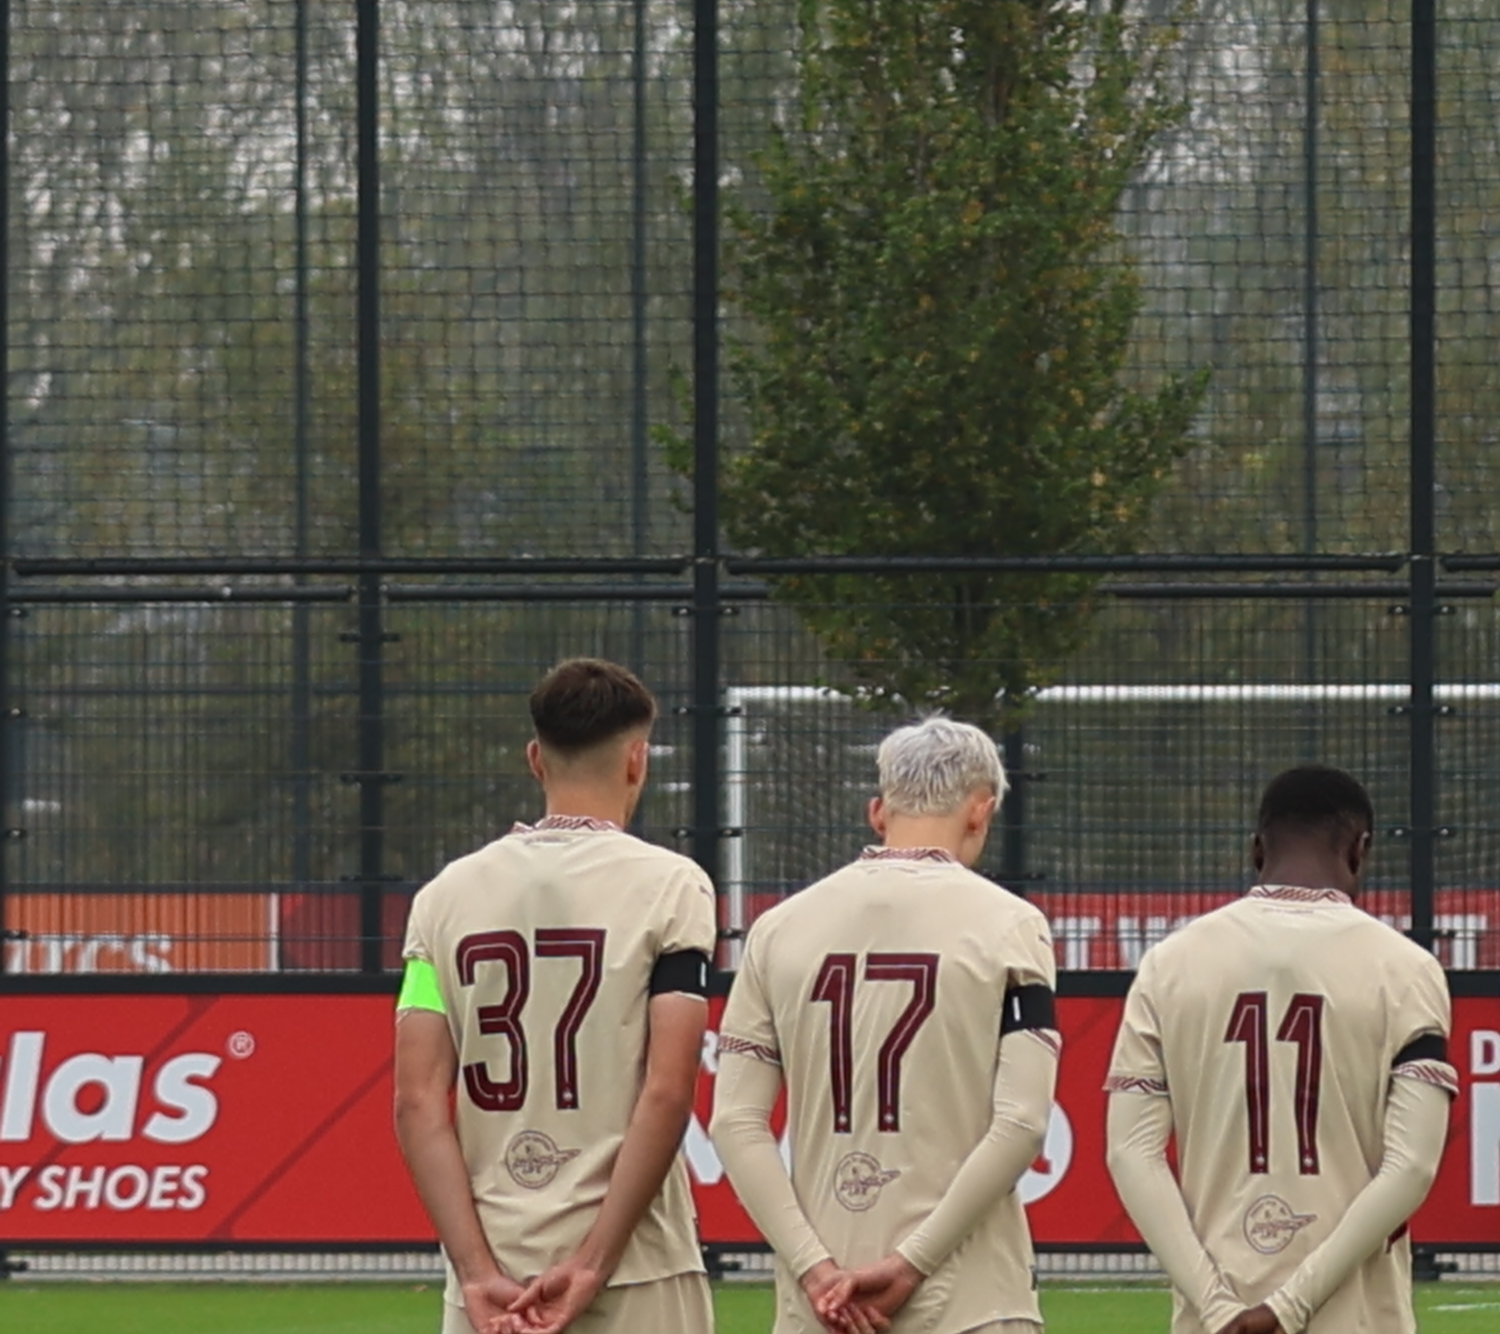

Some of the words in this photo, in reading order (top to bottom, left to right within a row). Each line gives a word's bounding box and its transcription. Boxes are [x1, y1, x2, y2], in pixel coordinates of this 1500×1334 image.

[455, 928, 607, 1112] 37
[810, 952, 940, 1133] 17
[1223, 991, 1325, 1176] 11
[34, 1164, 209, 1210] SHOES
